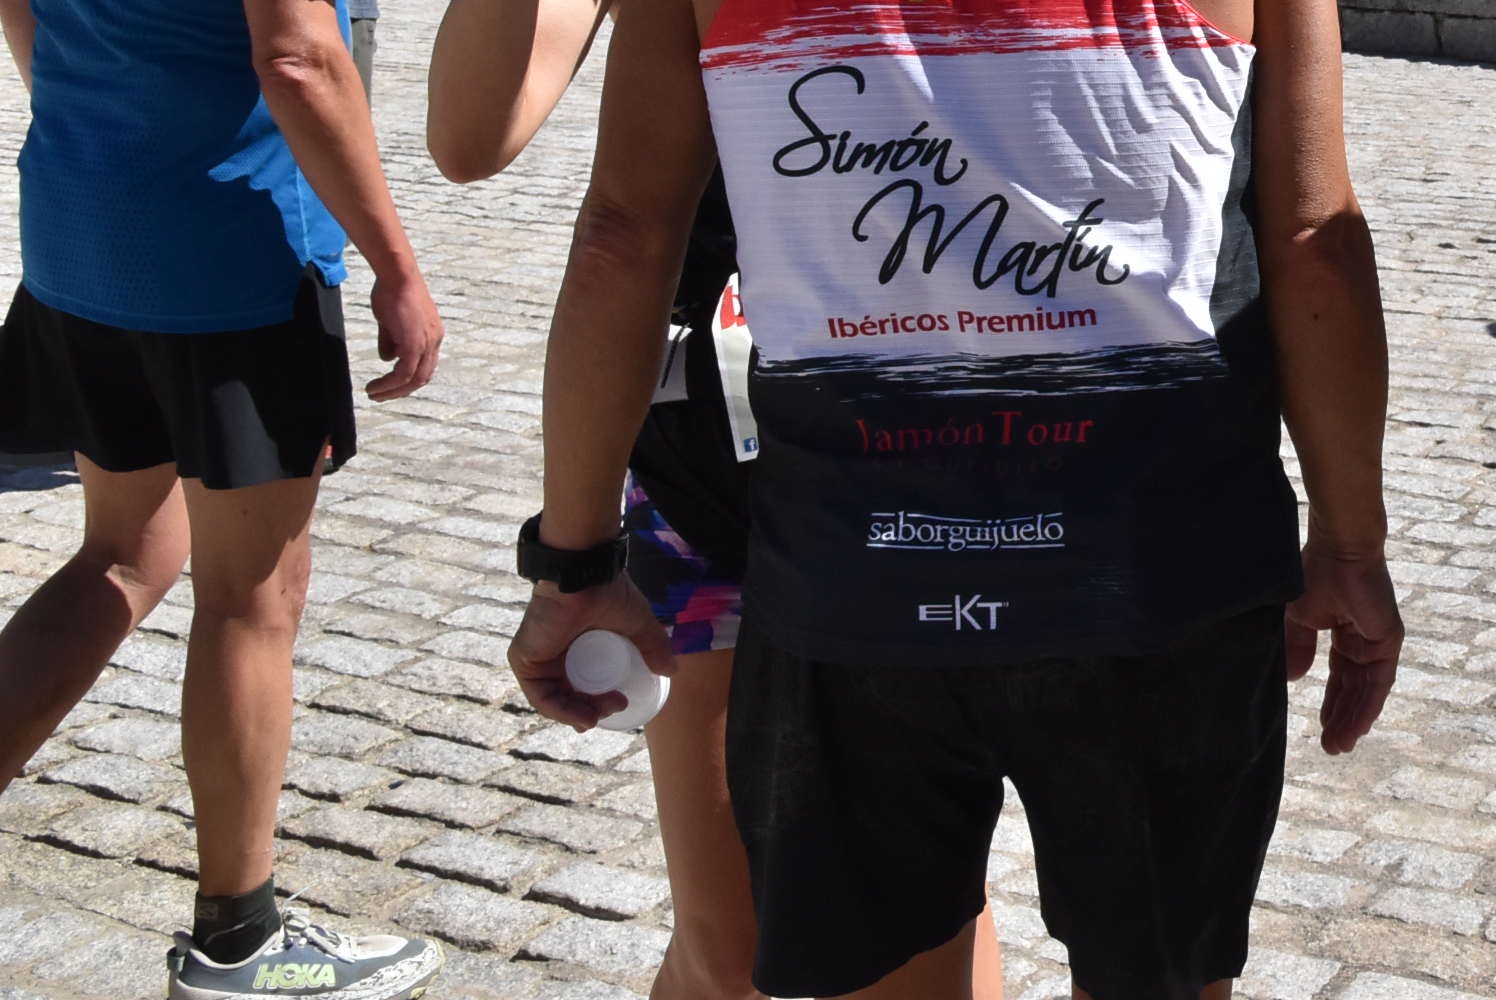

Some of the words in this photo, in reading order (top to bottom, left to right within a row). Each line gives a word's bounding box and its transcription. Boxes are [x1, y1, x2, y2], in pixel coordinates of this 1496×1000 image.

[772, 64, 968, 186] Simón
[852, 178, 1131, 298] Martín
[828, 312, 948, 338] Ibéricos
[957, 306, 1098, 334] Premium
[992, 410, 1094, 446] Tour
[868, 510, 1064, 552] saborguijuelo
[252, 962, 337, 989] HOKA
